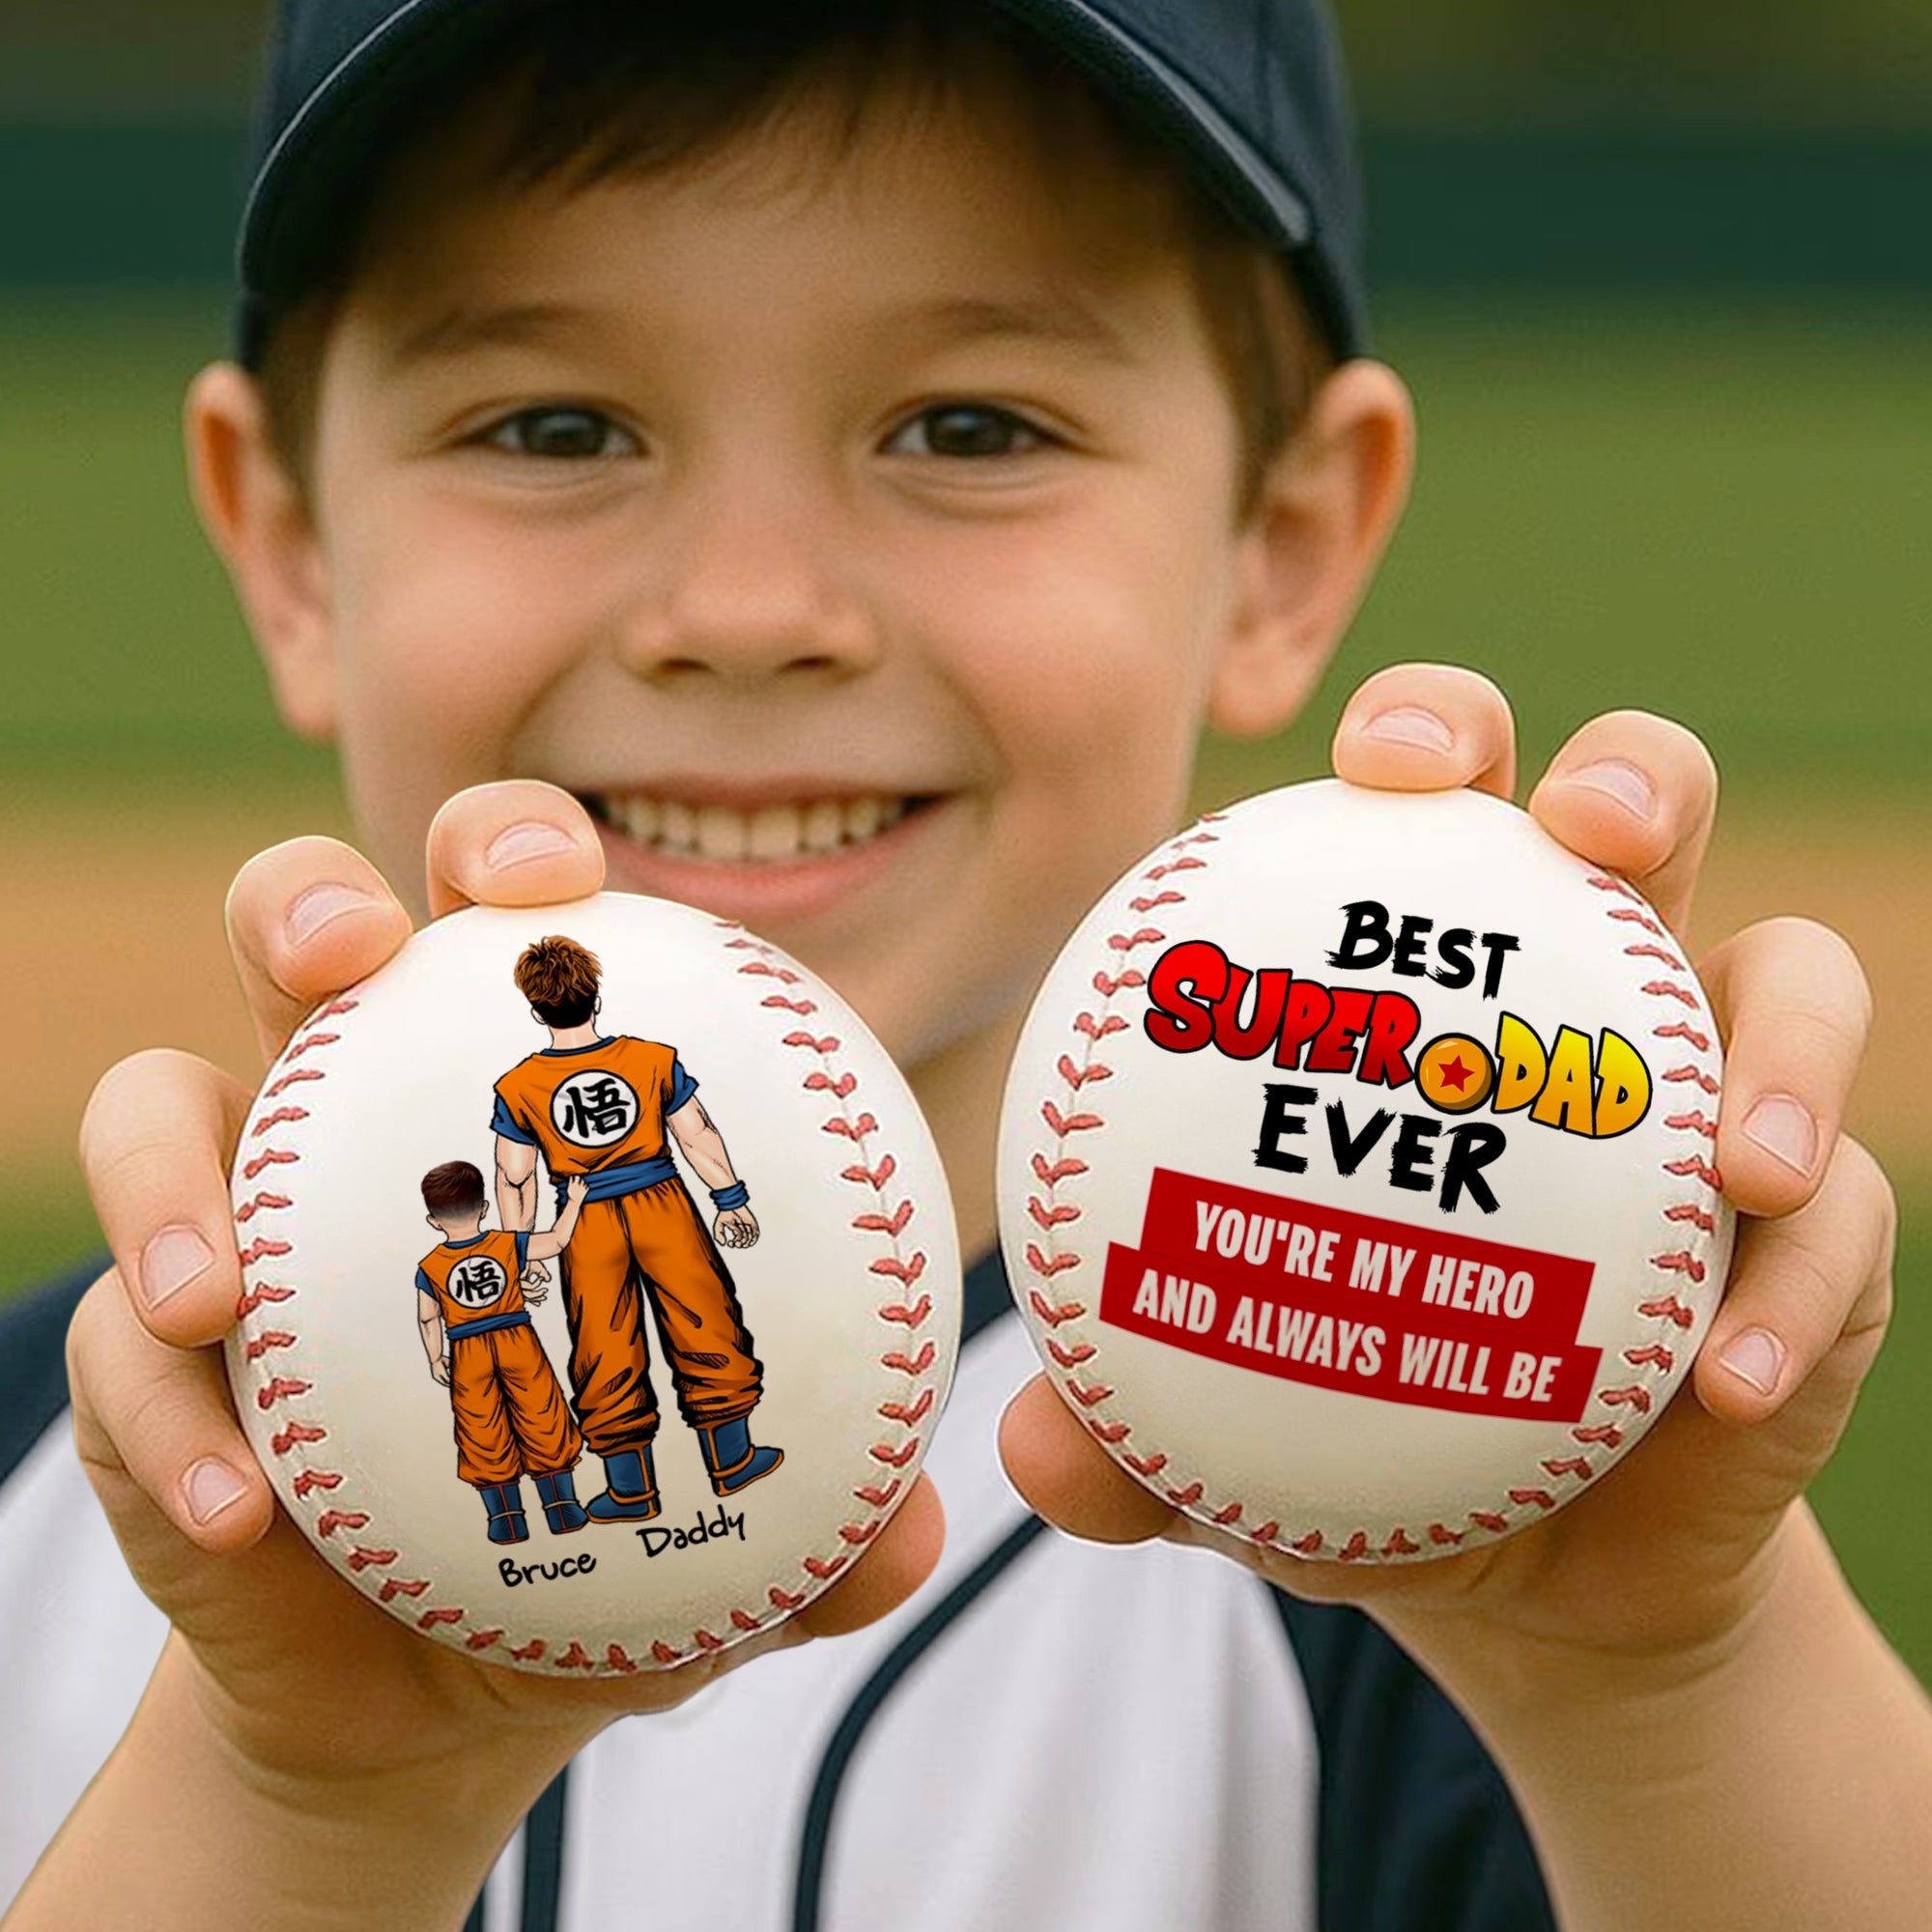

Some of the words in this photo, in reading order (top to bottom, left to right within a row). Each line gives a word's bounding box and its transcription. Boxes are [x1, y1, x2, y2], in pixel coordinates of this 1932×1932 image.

[1325, 900, 1521, 1002] BEST
[1144, 940, 1421, 1090] SUPER
[1491, 1010, 1653, 1139] DAD
[563, 1078, 631, 1138] 悟
[1252, 1082, 1506, 1214] EVER
[456, 1261, 500, 1302] 悟
[1194, 1200, 1341, 1282] YOU'RE
[1349, 1238, 1417, 1298] MY
[1423, 1257, 1534, 1321] HERO
[1132, 1268, 1217, 1335] AND
[1226, 1296, 1386, 1378] ALWAYS
[1398, 1331, 1490, 1397] WILL
[1503, 1351, 1562, 1403] BE
[498, 1552, 596, 1587] Bruce
[637, 1505, 746, 1557] Daddy
